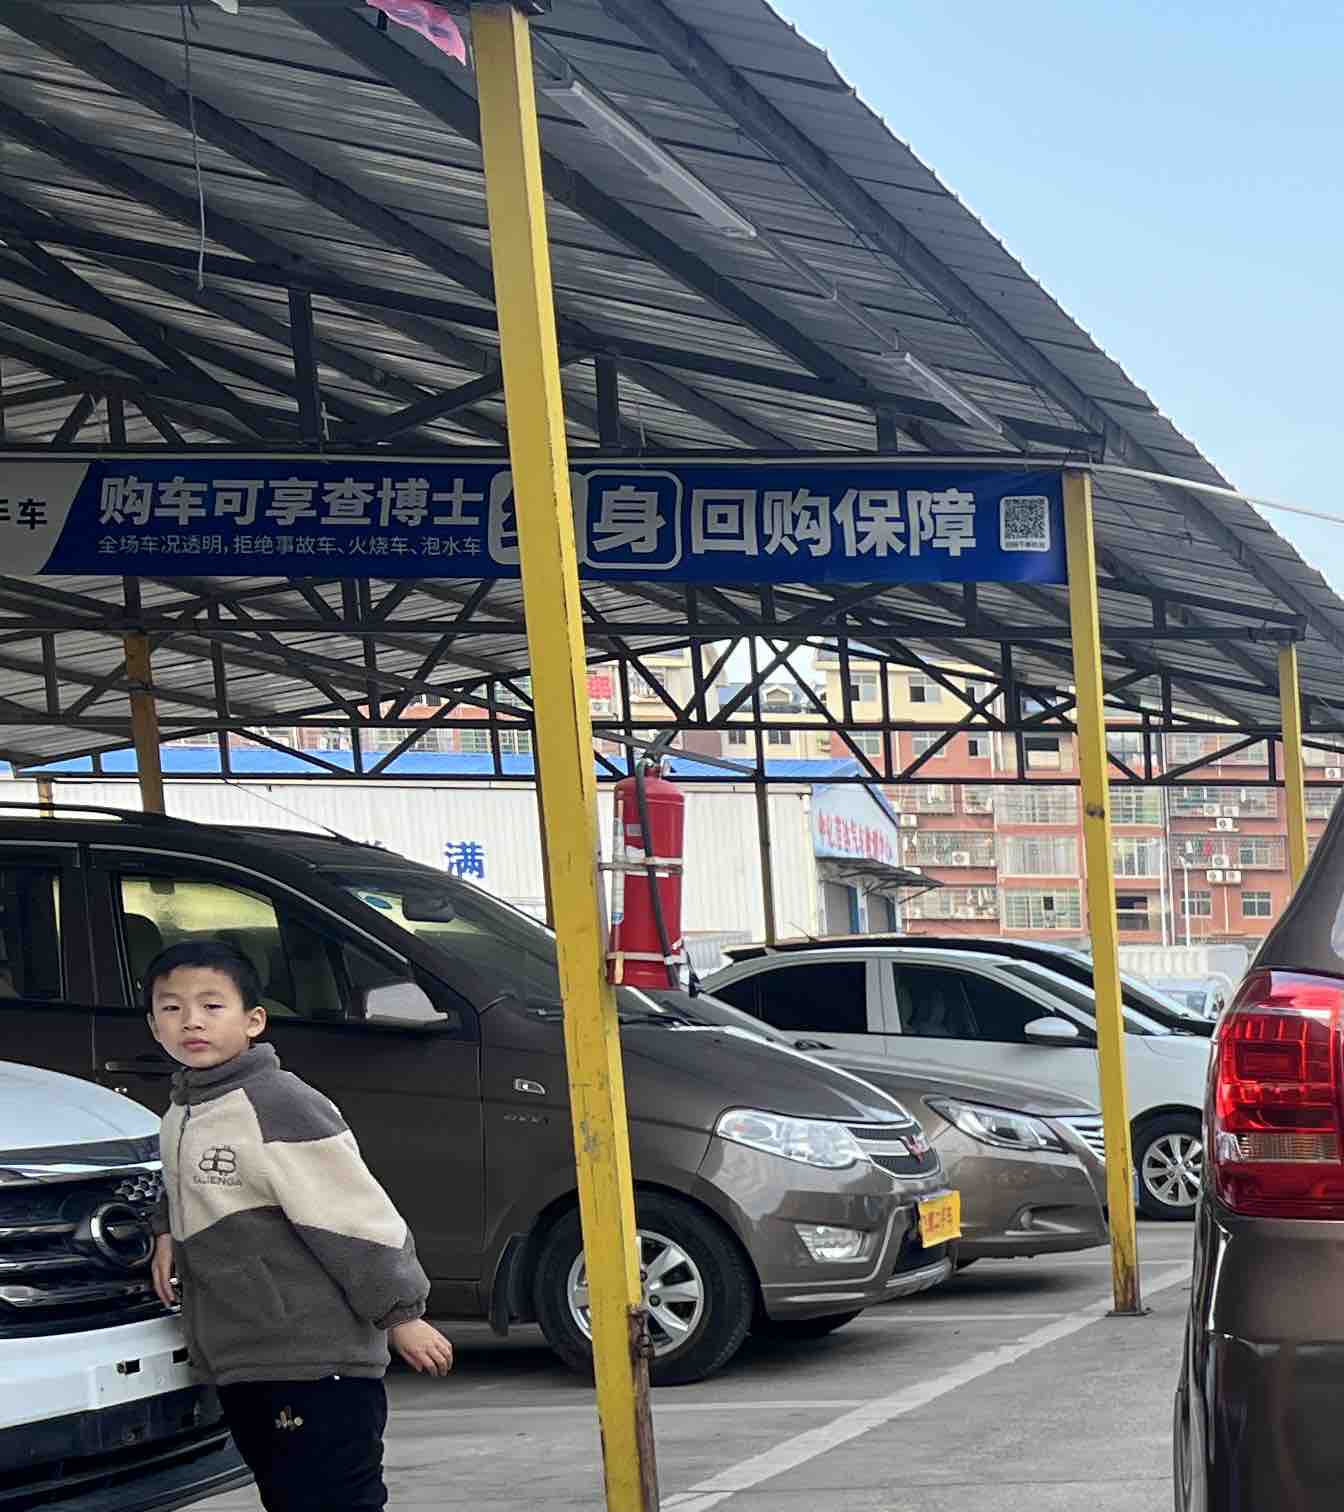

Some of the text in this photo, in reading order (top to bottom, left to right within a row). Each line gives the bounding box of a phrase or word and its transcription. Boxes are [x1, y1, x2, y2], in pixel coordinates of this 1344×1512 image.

[98, 475, 484, 527] 购车可享查博士
